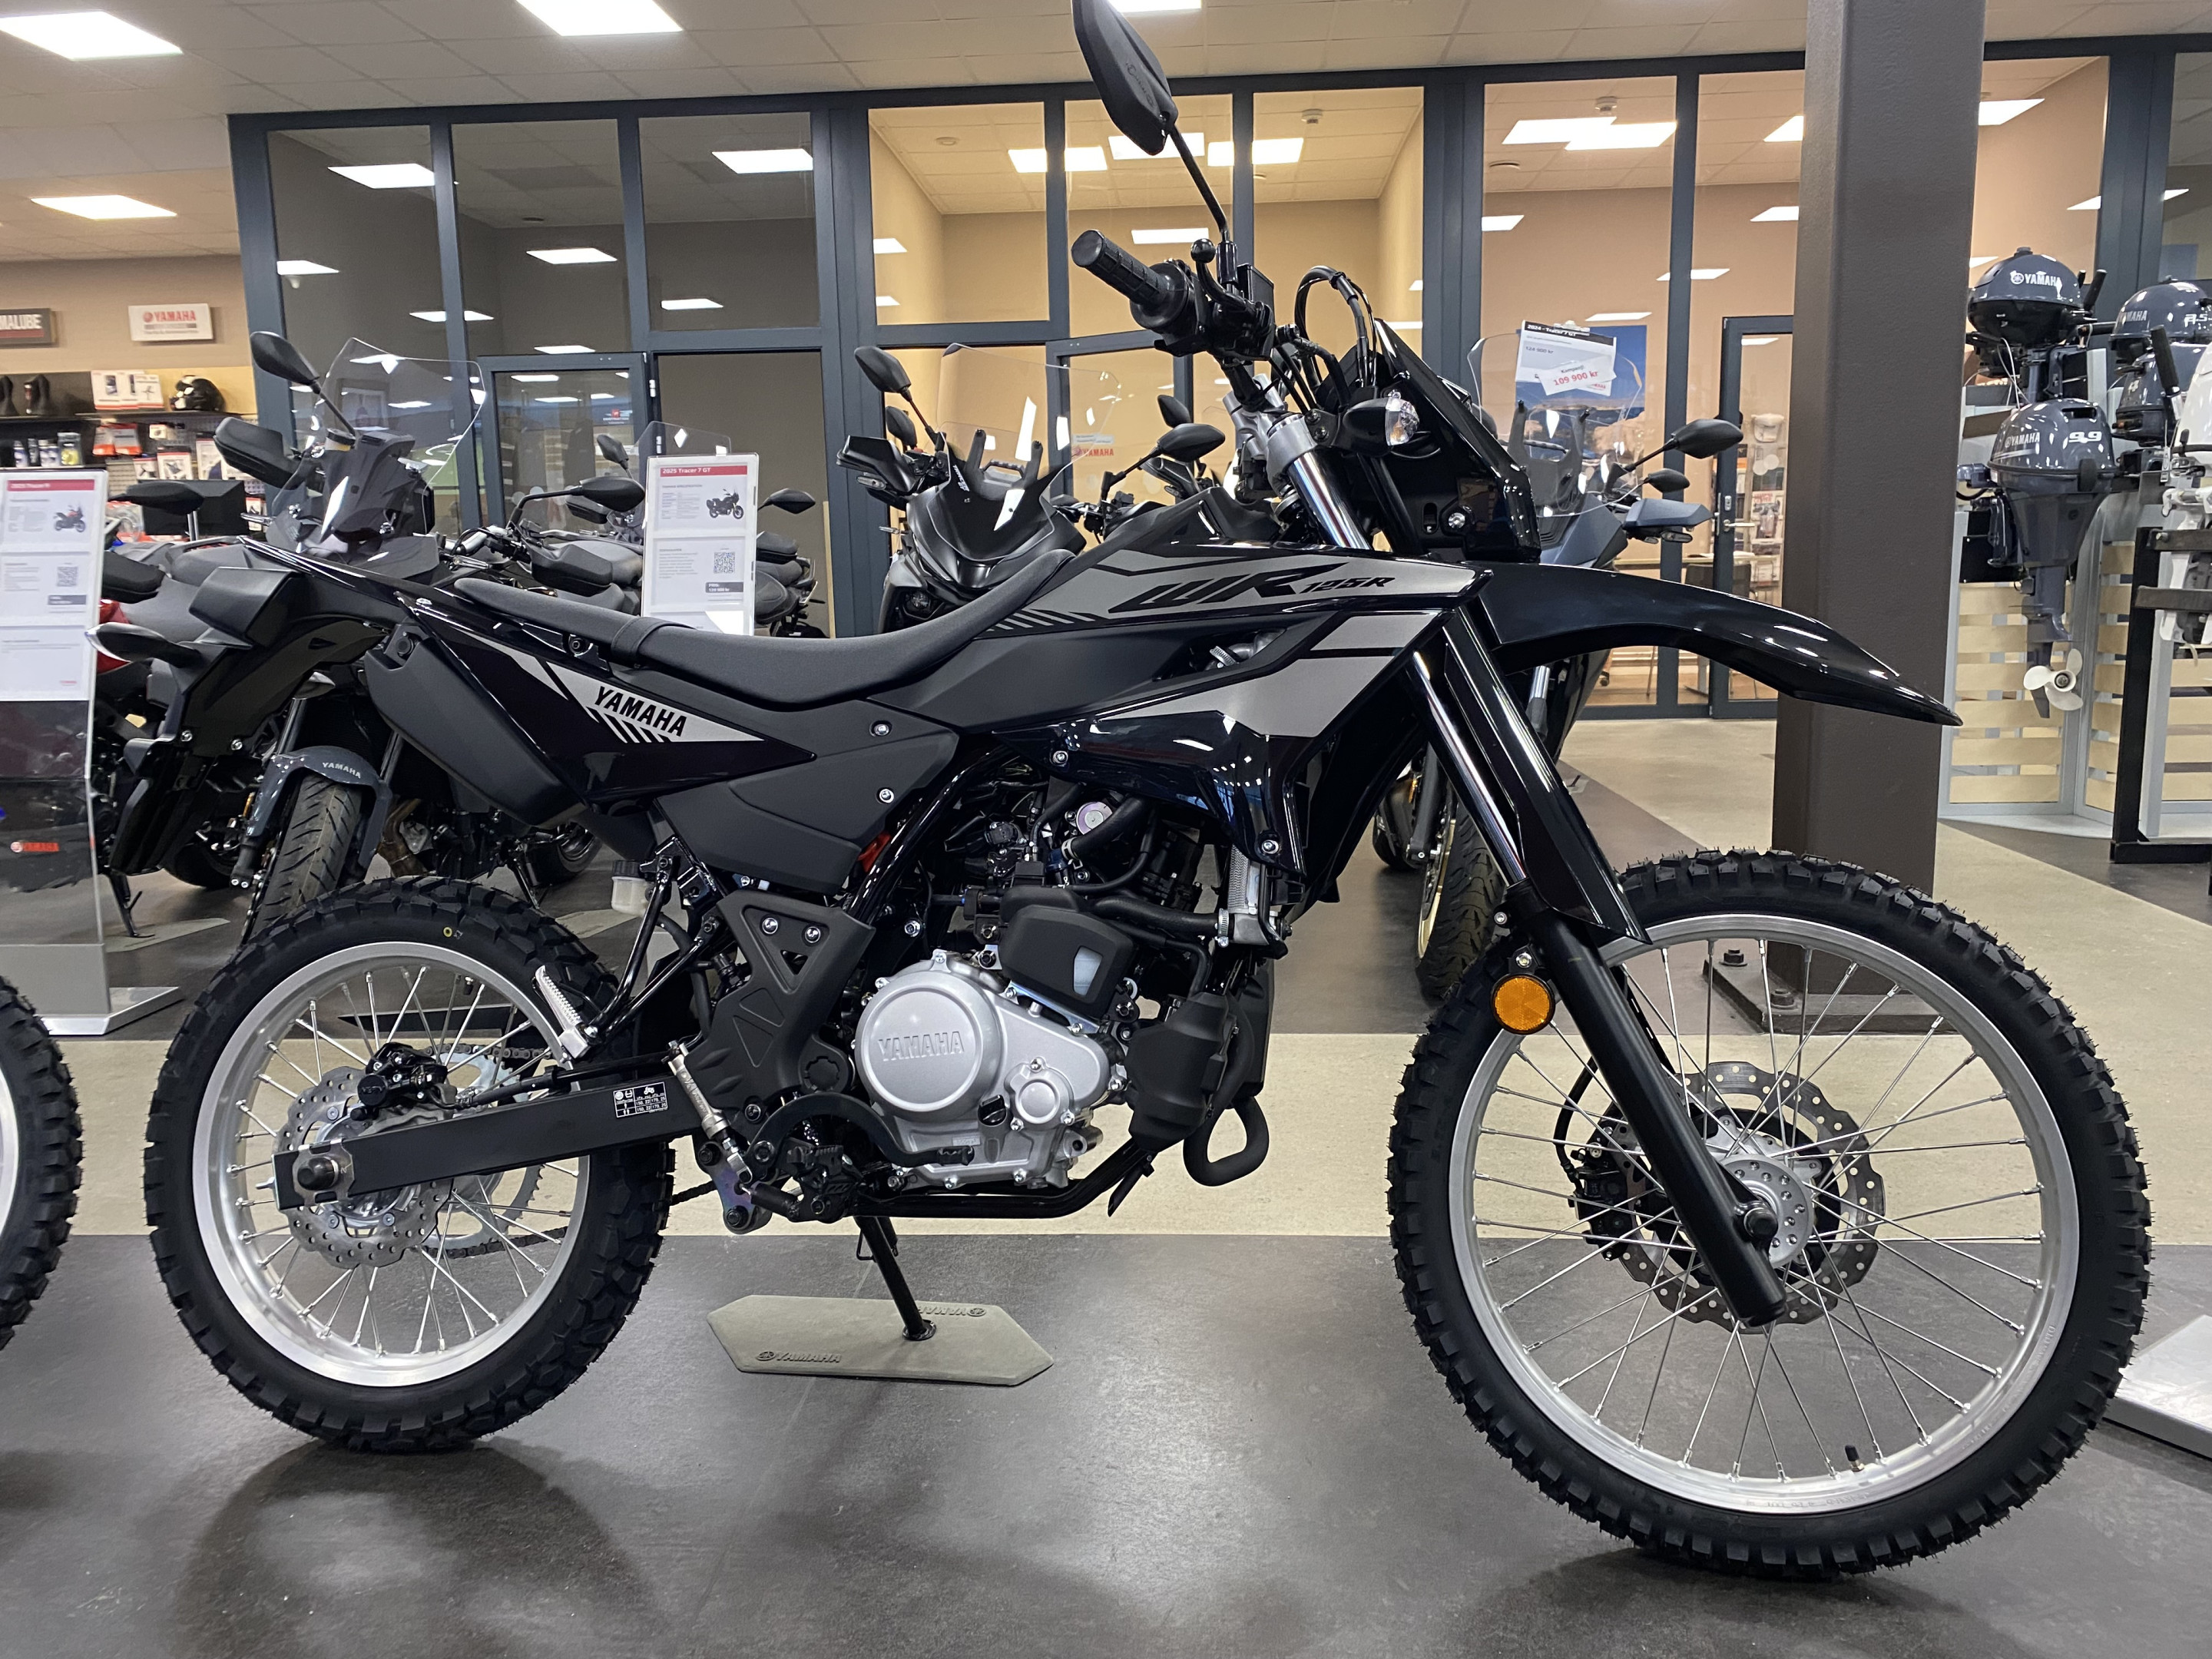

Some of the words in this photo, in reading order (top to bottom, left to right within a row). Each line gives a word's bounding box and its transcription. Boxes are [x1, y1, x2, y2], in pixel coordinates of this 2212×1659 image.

[2024, 273, 2061, 286] YAMAHA
[154, 310, 196, 322] YAMAHA
[1554, 376, 1570, 386] 109
[1571, 373, 1588, 382] 900
[2011, 432, 2040, 446] YAMAHA
[2068, 431, 2102, 444] 9.9
[1082, 449, 1114, 457] YAMAHA
[1108, 562, 1349, 613] WR
[1300, 577, 1396, 594] 125R
[594, 686, 687, 737] YAMAHA
[323, 762, 361, 779] YAMAHA
[878, 1031, 965, 1061] YAMAHA
[777, 1353, 842, 1363] YAMAHA
